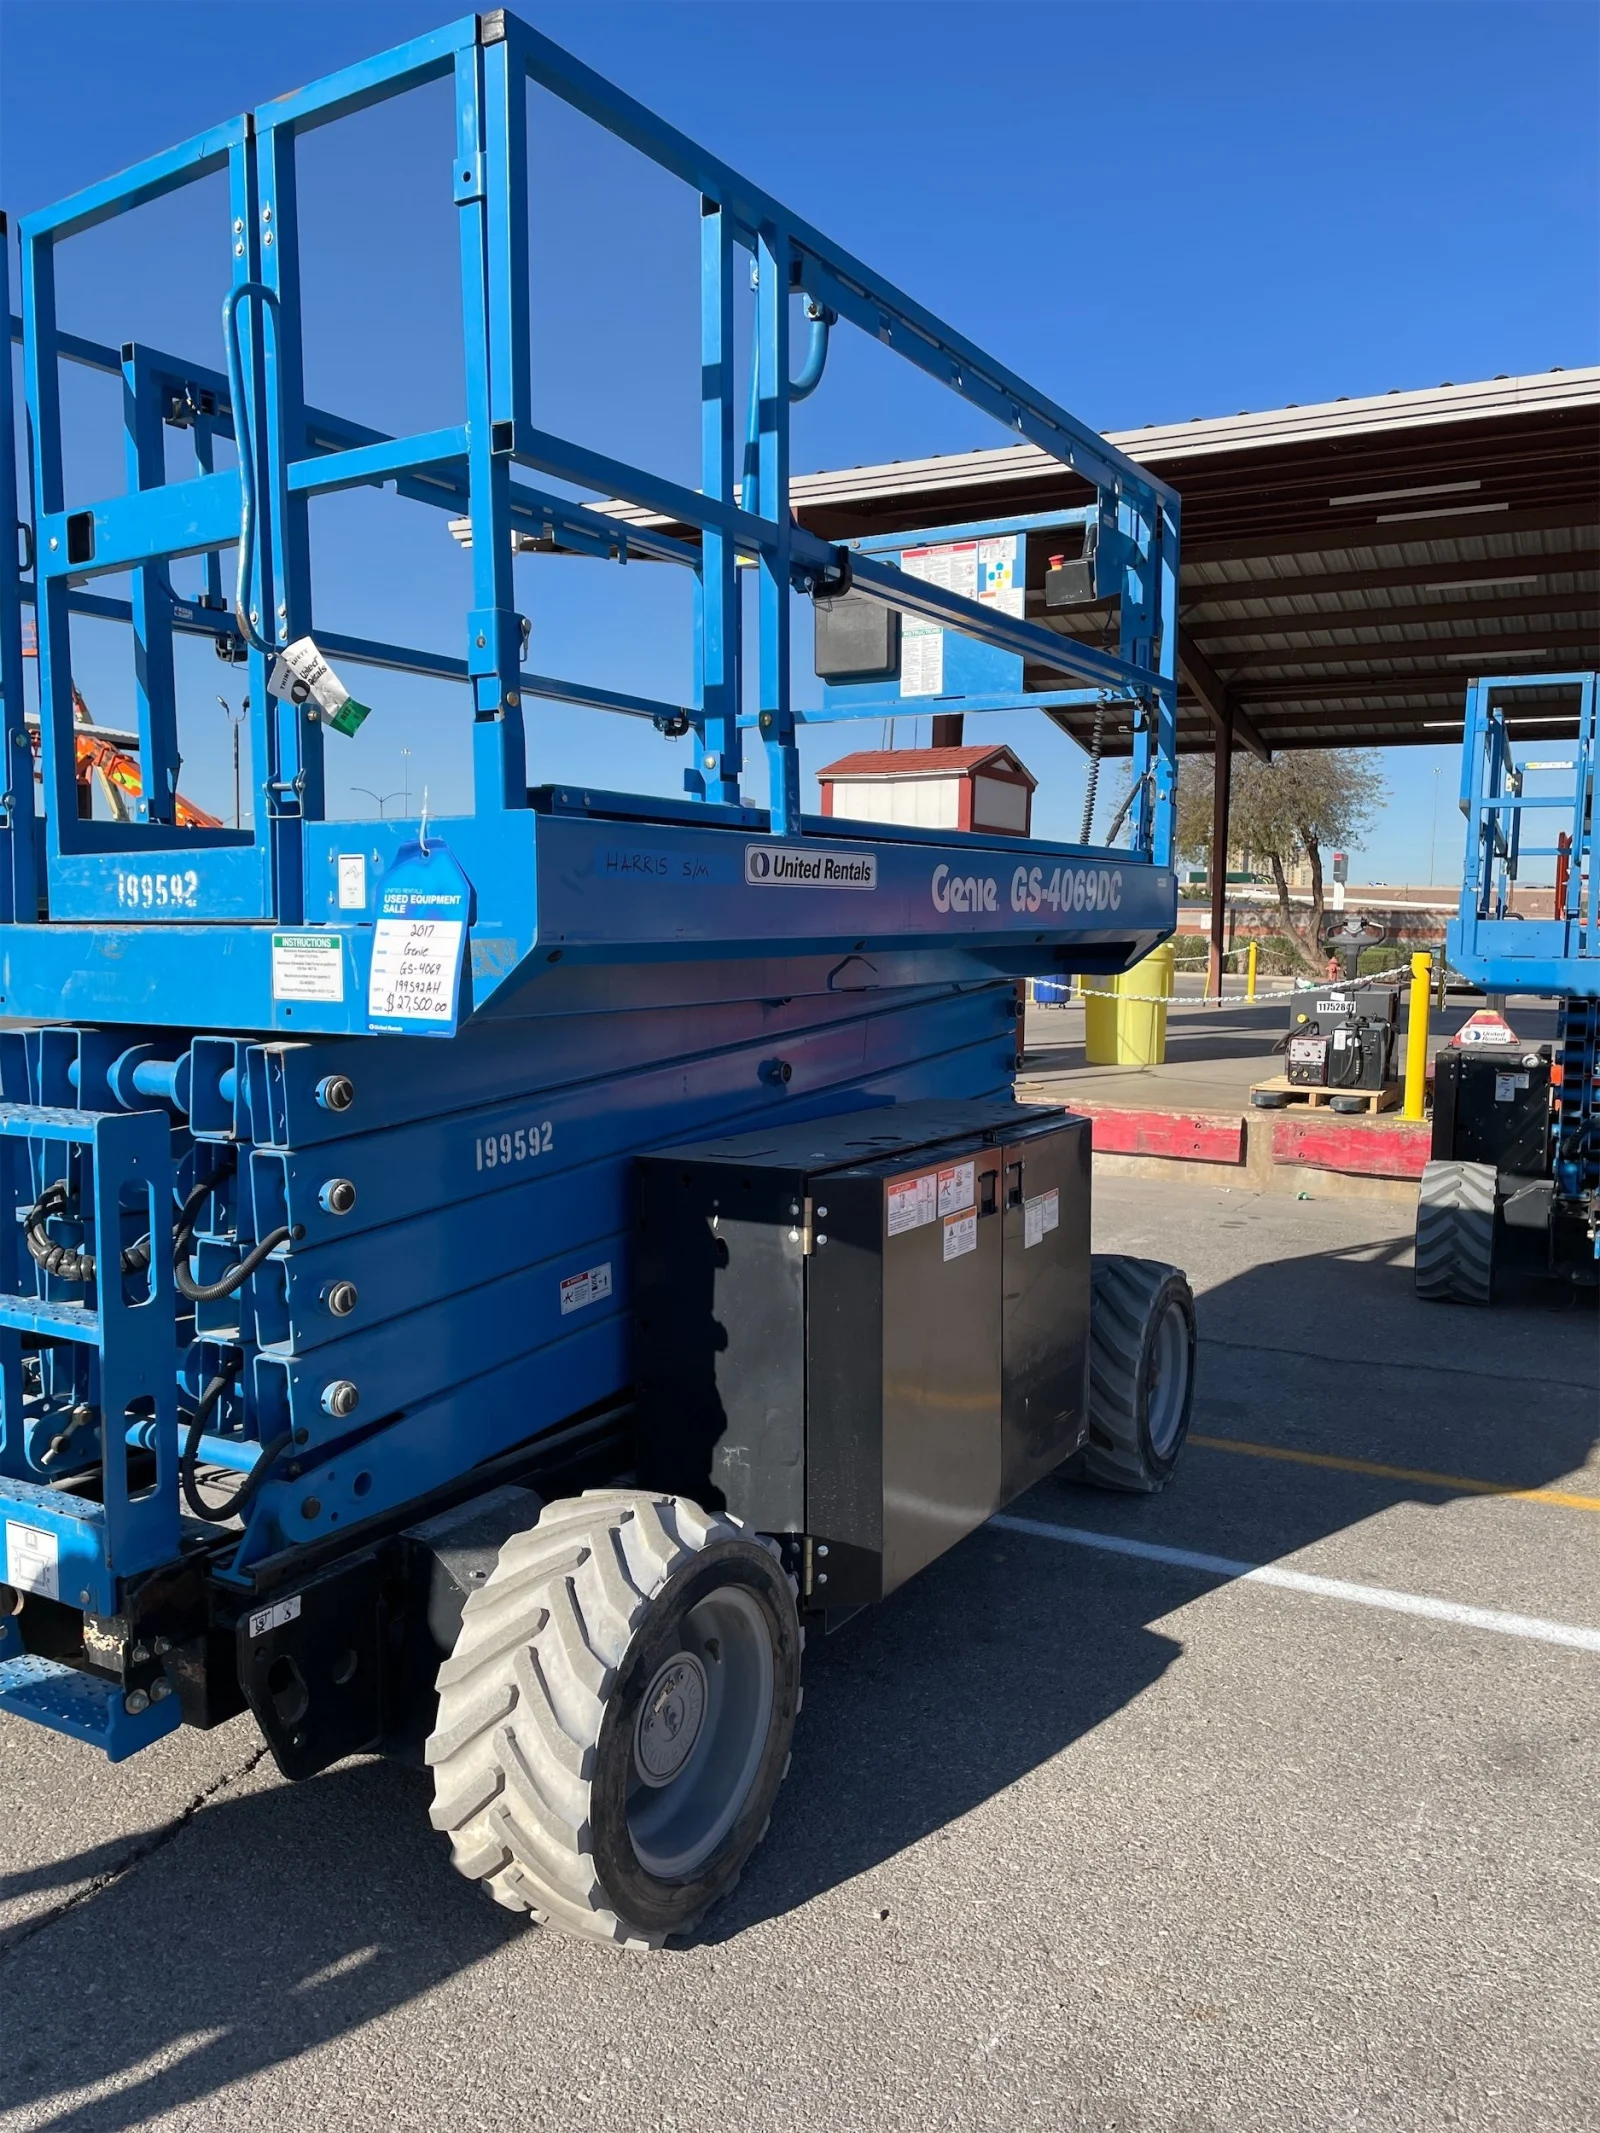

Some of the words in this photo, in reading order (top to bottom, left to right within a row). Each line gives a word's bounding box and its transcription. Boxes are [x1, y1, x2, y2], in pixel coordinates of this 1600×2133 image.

[299, 656, 318, 680] Uted
[307, 665, 328, 686] Rtals
[280, 669, 291, 690] THINK
[606, 852, 668, 875] HARRIS
[682, 857, 710, 880] S/M
[773, 855, 822, 878] United
[824, 858, 871, 881] Rentals
[118, 870, 198, 909] 199592
[931, 864, 998, 913] Genie
[1010, 866, 1123, 913] GS-4069DC
[382, 904, 406, 913] SALE
[384, 894, 408, 904] USED
[410, 895, 462, 905] EQUIPMENT
[410, 924, 435, 938] 2017
[282, 937, 332, 948] INSTRUCTIONS
[404, 942, 429, 957] Genie
[400, 961, 441, 976] GS-4069
[395, 980, 442, 995] 199592AH
[475, 1121, 554, 1172] 199592
